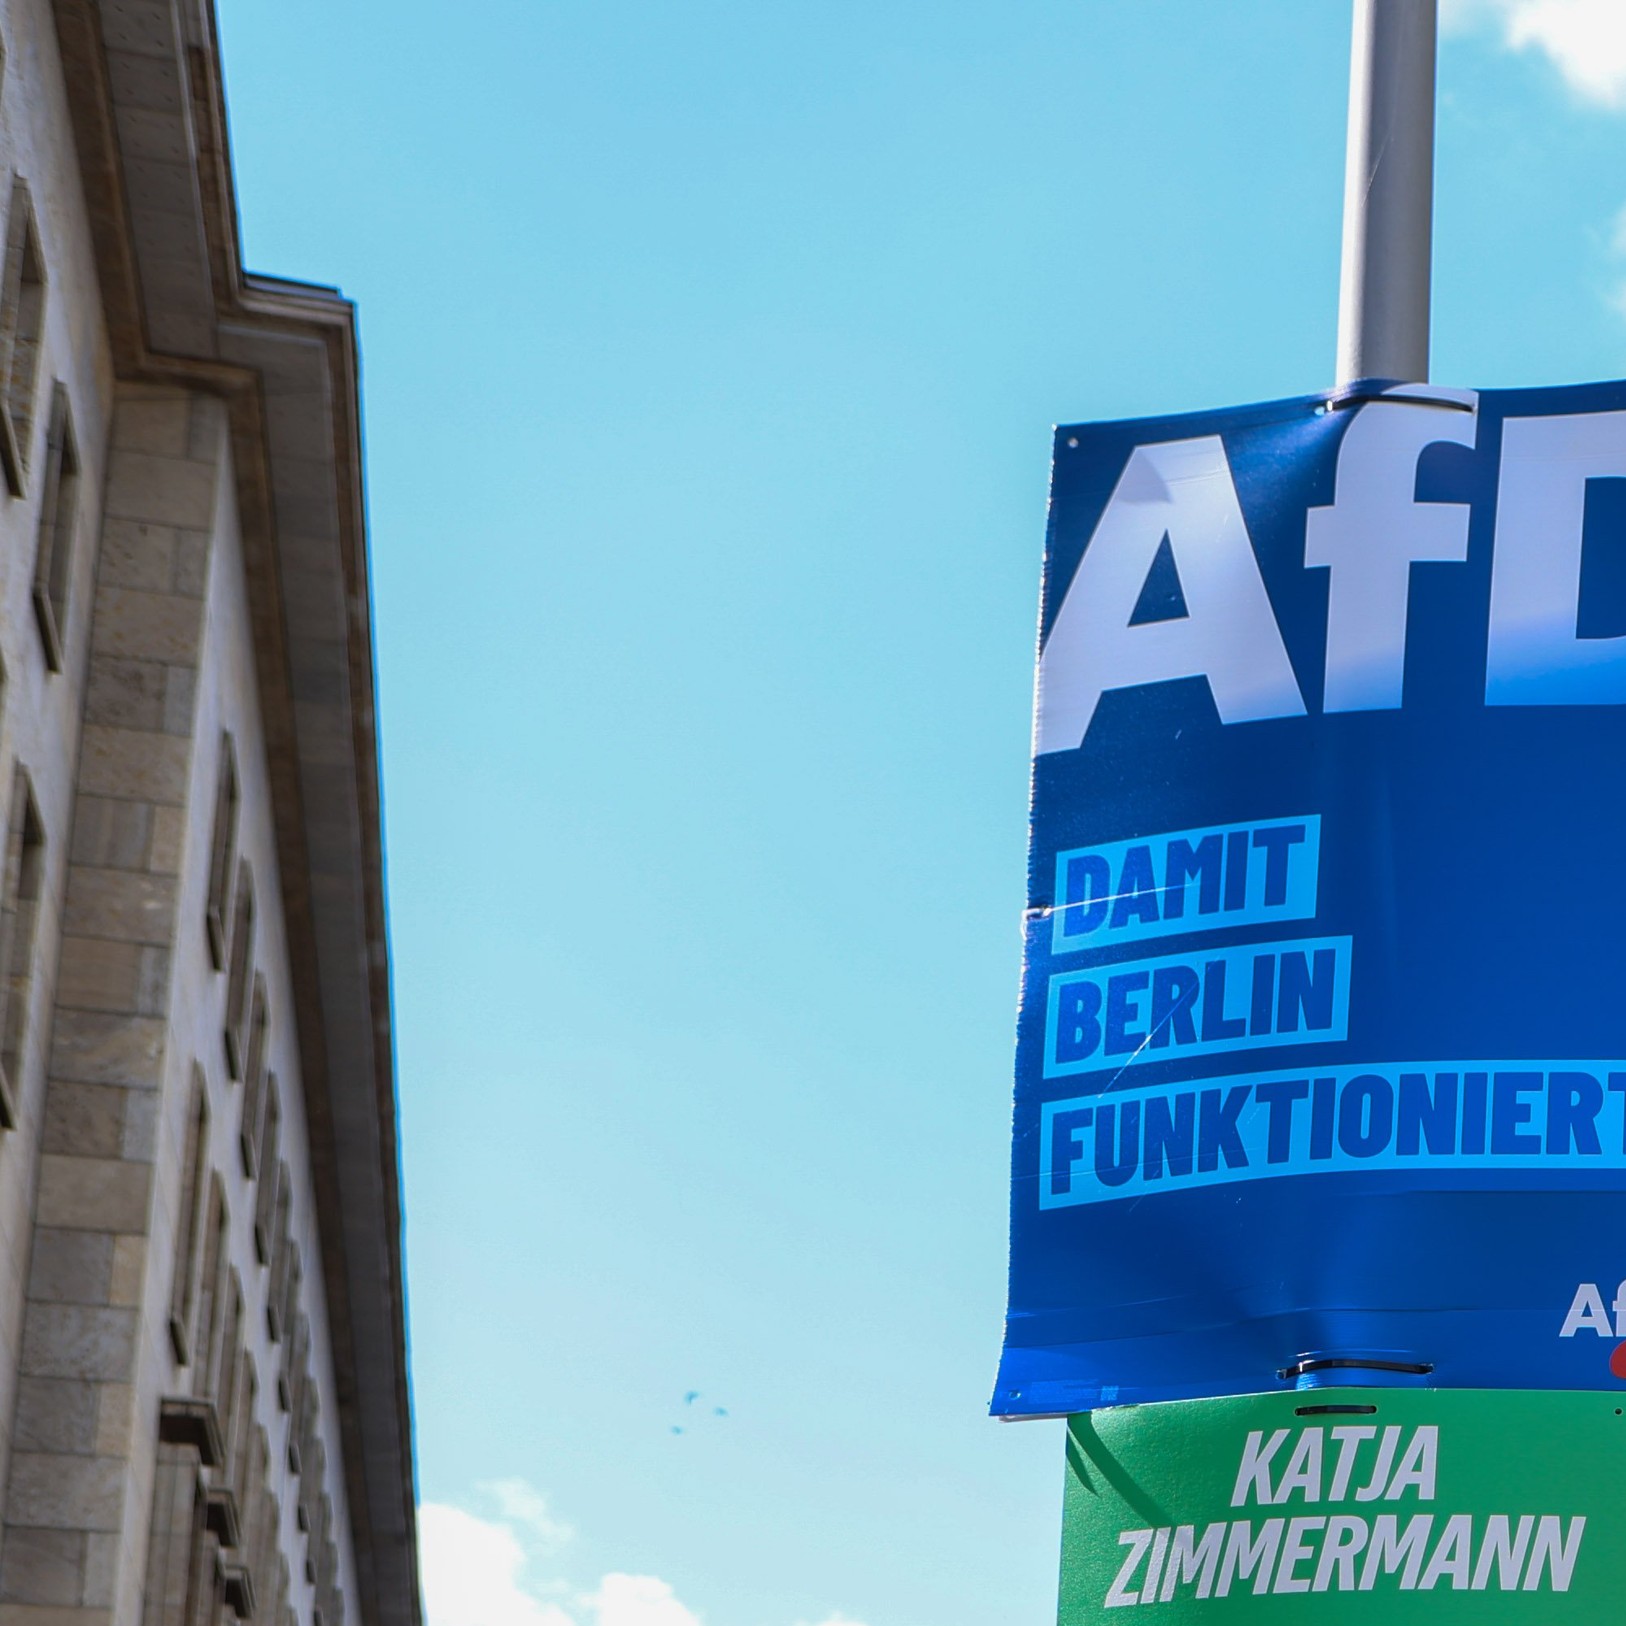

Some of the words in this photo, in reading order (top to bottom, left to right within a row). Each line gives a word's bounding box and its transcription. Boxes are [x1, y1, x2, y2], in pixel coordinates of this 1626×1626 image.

[1064, 824, 1306, 937] DAMIT
[1057, 947, 1337, 1060] BERLIN
[1230, 1425, 1439, 1508] KATJA
[1103, 1515, 1587, 1608] ZIMMERMANN
